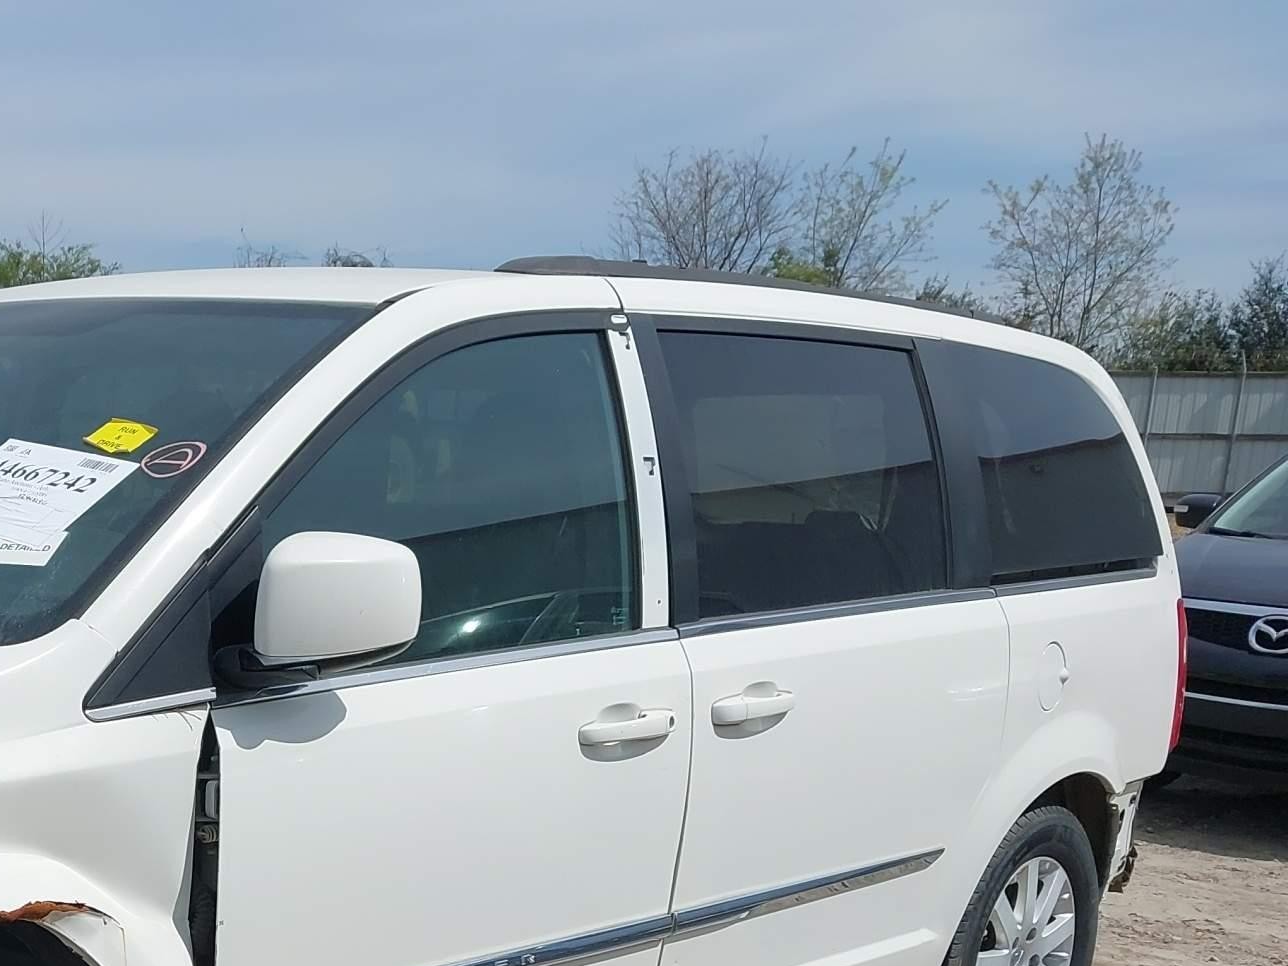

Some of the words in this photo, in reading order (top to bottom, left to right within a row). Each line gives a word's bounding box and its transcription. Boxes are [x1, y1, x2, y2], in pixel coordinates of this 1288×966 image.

[117, 426, 139, 436] RUN
[96, 439, 124, 450] DRIVE
[0, 543, 52, 552] DETAID
